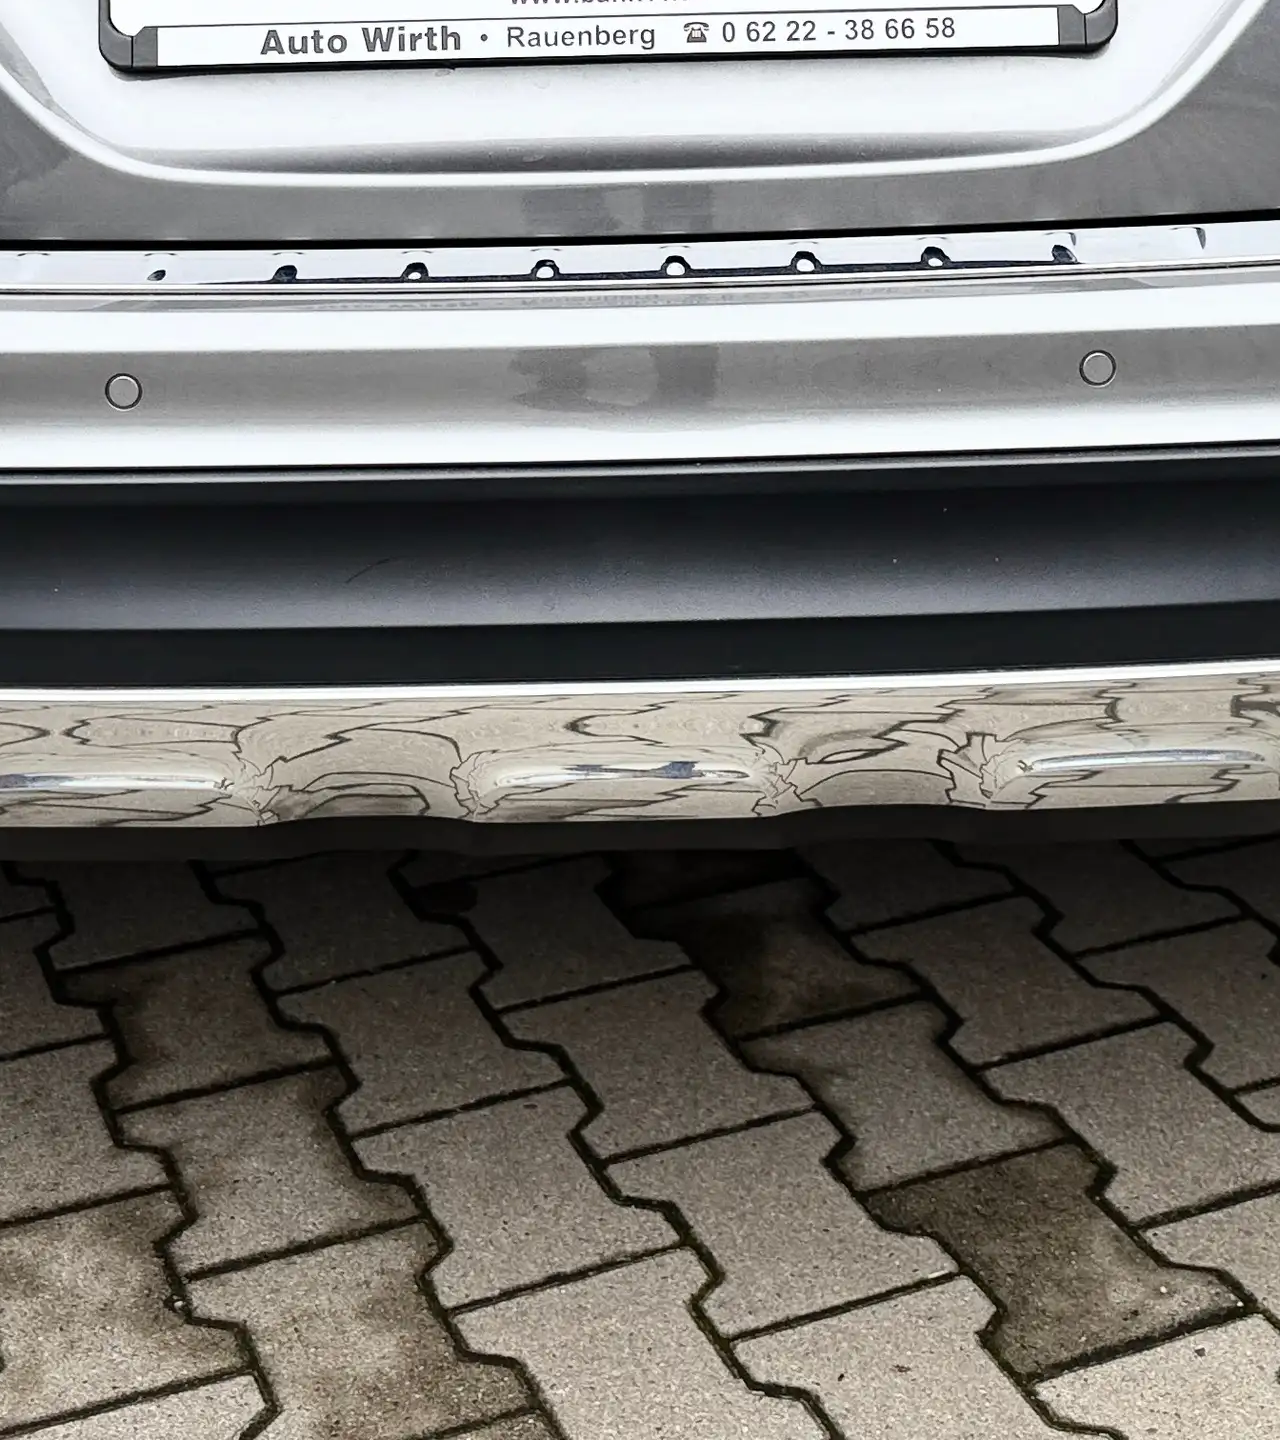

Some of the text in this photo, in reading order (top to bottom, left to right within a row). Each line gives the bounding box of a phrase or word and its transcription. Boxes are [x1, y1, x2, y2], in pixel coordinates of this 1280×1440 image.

[260, 29, 348, 55] Auto
[361, 25, 461, 53] Wirth
[507, 24, 656, 51] Rauenberg
[722, 21, 736, 43] 0
[746, 20, 776, 43] 62
[786, 20, 817, 42] 22
[845, 18, 875, 41] 38
[885, 18, 916, 40] 66
[926, 17, 956, 39] 58
